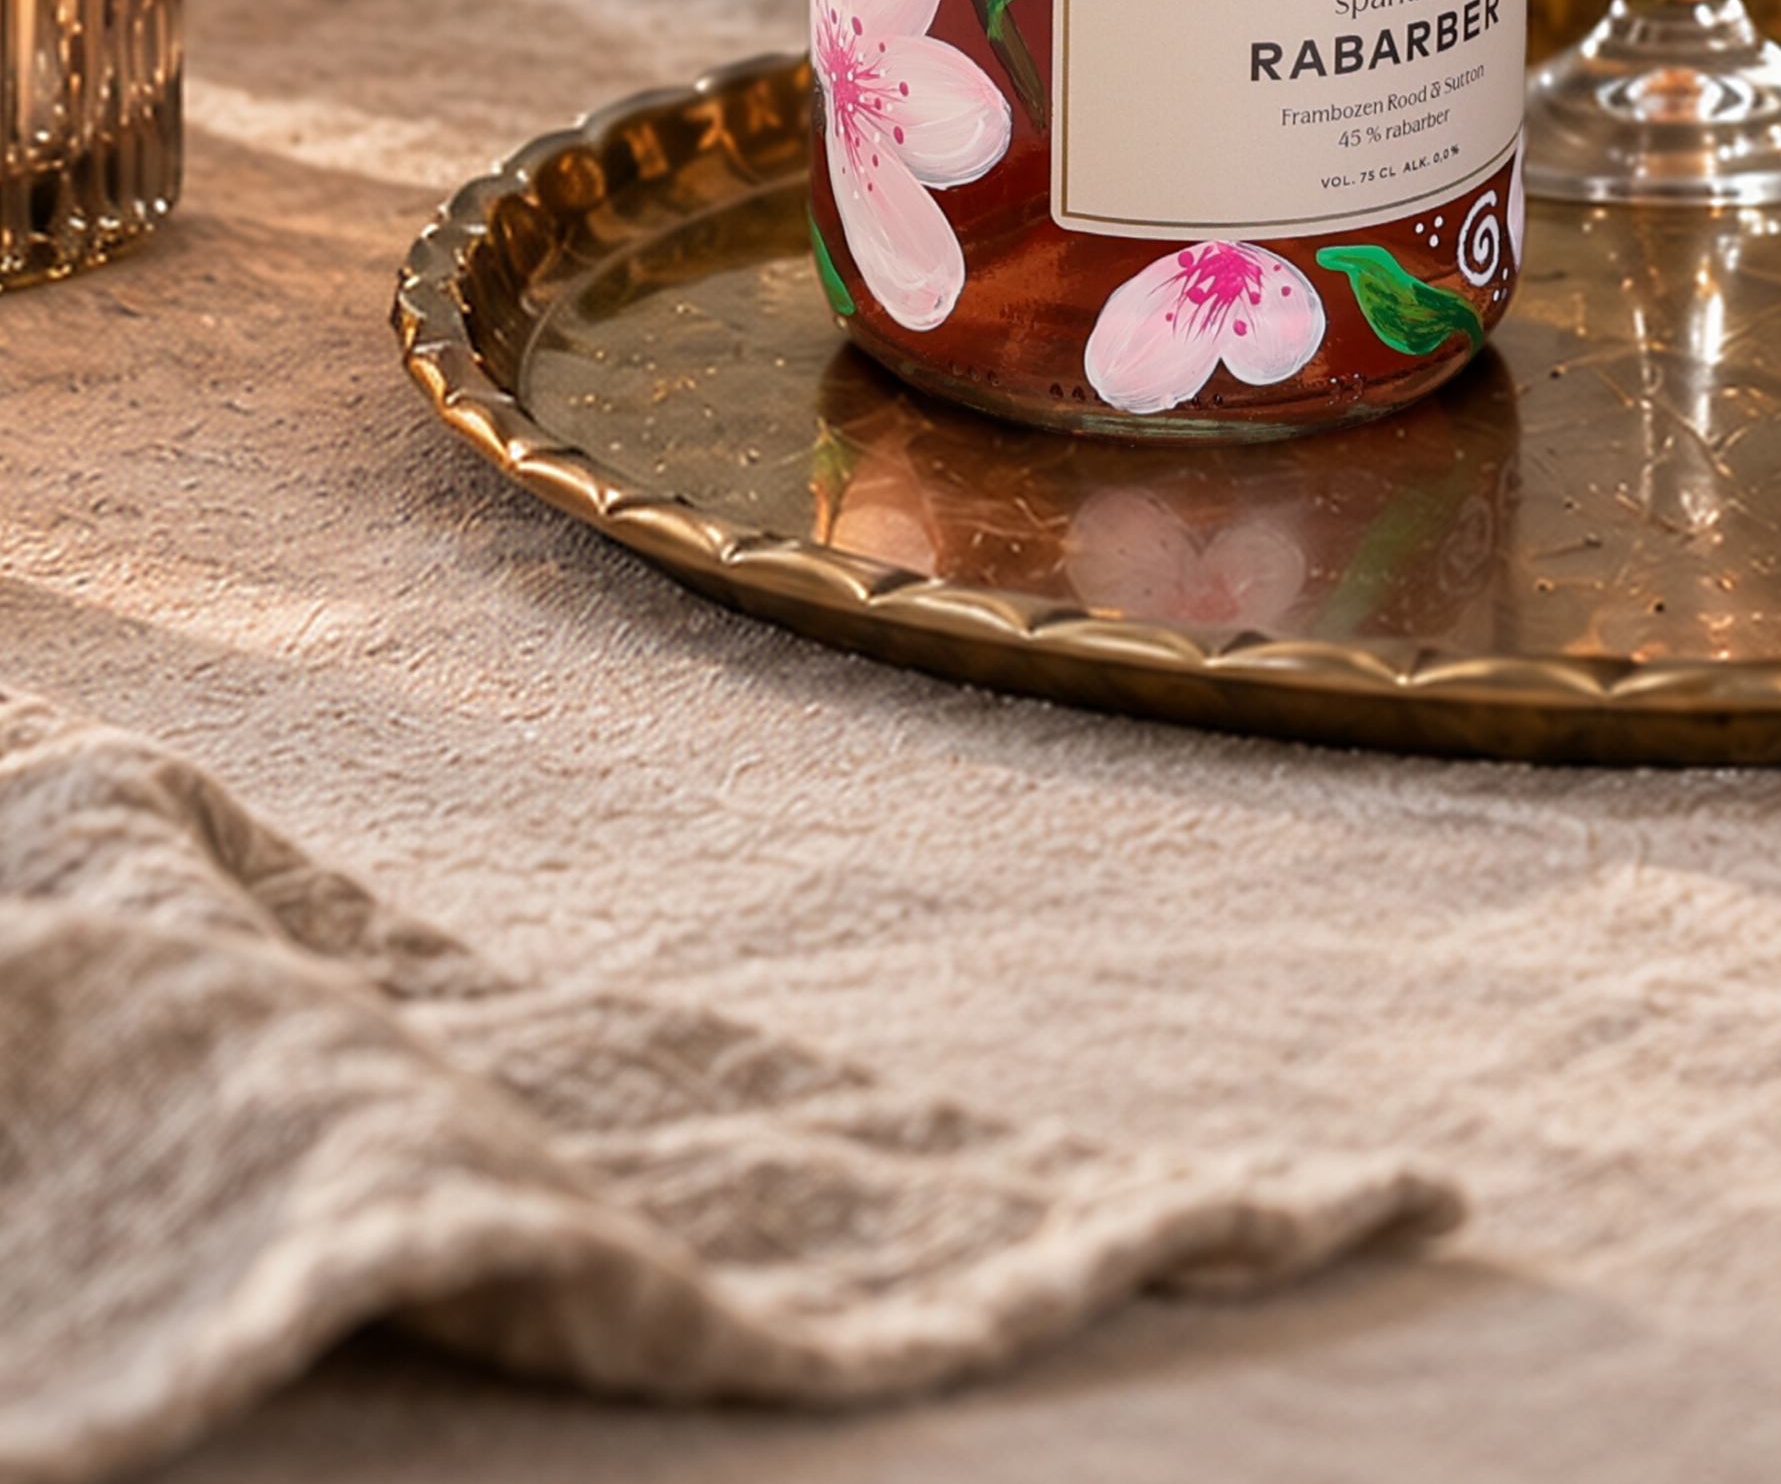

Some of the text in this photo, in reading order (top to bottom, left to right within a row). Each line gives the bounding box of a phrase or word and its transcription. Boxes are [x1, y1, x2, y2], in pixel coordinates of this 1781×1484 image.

[1281, 64, 1485, 127] Frambozen Rood & Sutton
[1338, 128, 1362, 149] 45
[1385, 108, 1451, 141] rabarber
[1321, 174, 1356, 190] VOL.
[1360, 170, 1376, 184] 75
[1379, 165, 1397, 180] CL
[1403, 155, 1431, 175] ALK.
